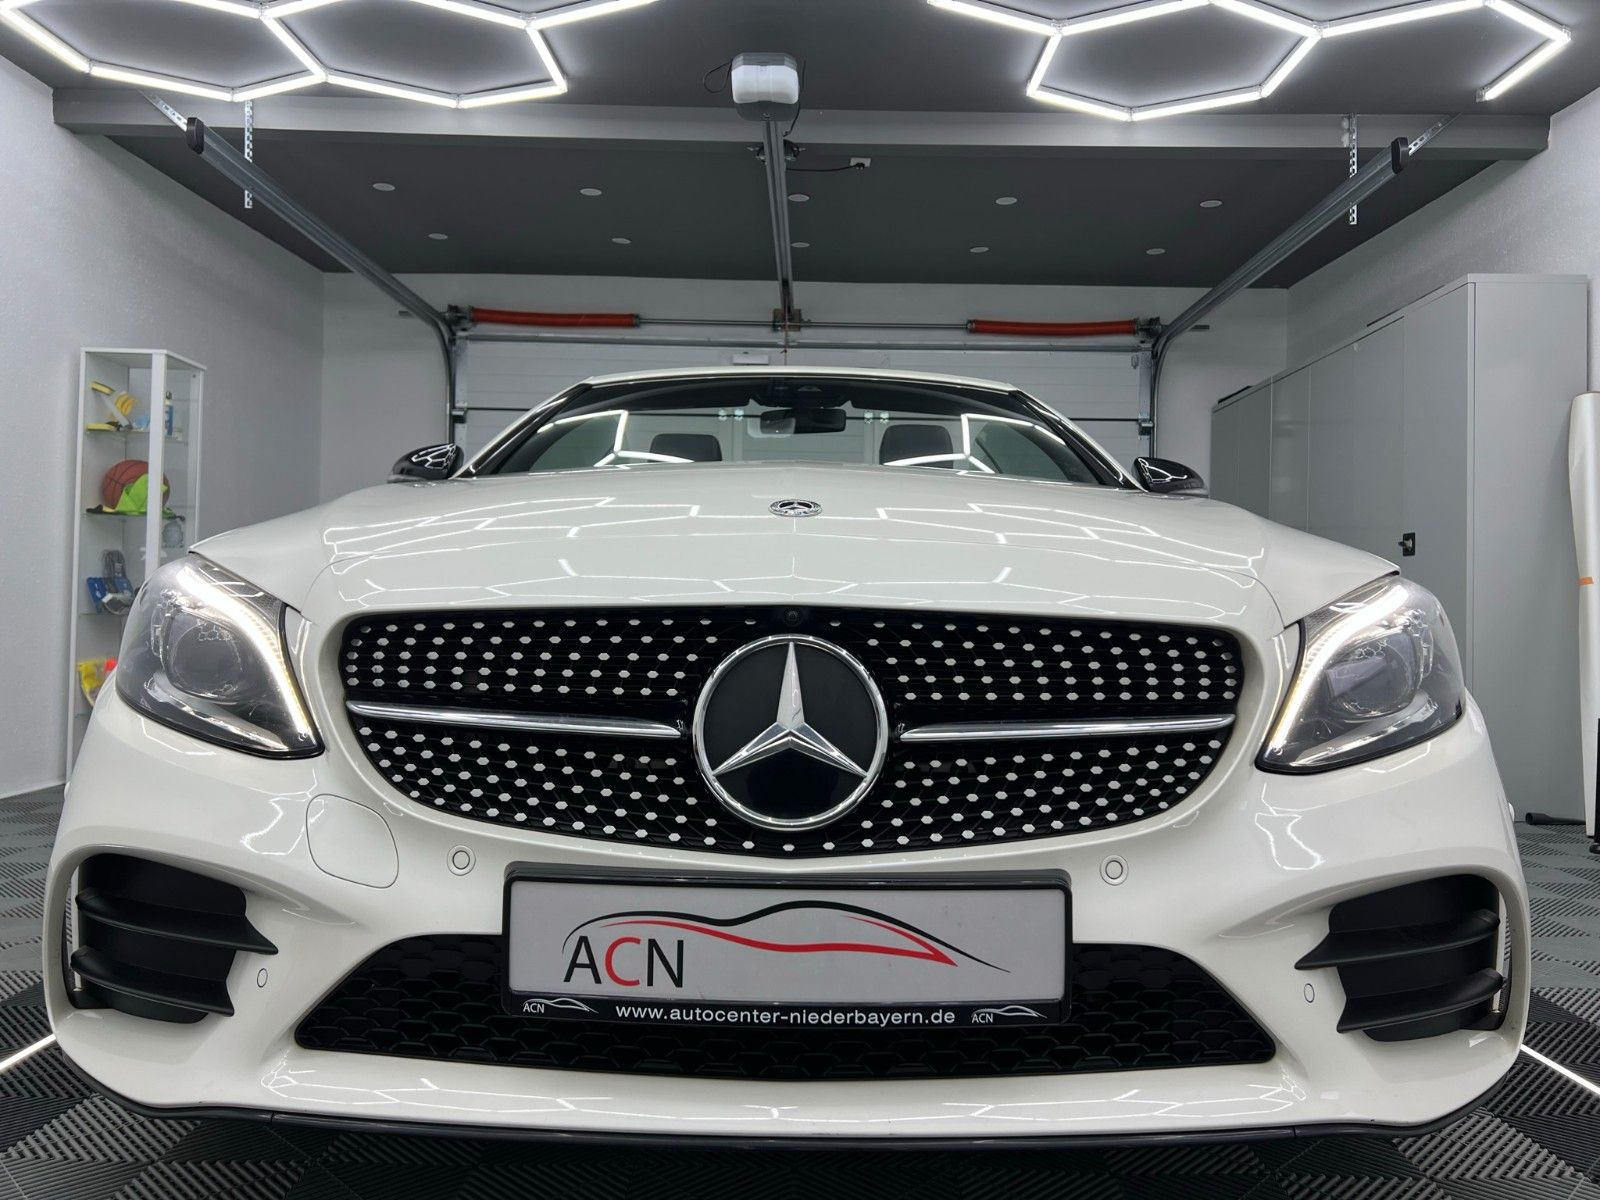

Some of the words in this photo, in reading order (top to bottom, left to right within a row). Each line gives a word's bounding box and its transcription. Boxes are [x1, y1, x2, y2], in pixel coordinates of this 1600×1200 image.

[563, 935, 684, 988] ACN
[522, 1001, 545, 1014] ACN
[615, 1005, 956, 1027] www.autocenter-niederbayern.de
[971, 1012, 994, 1024] ACN
